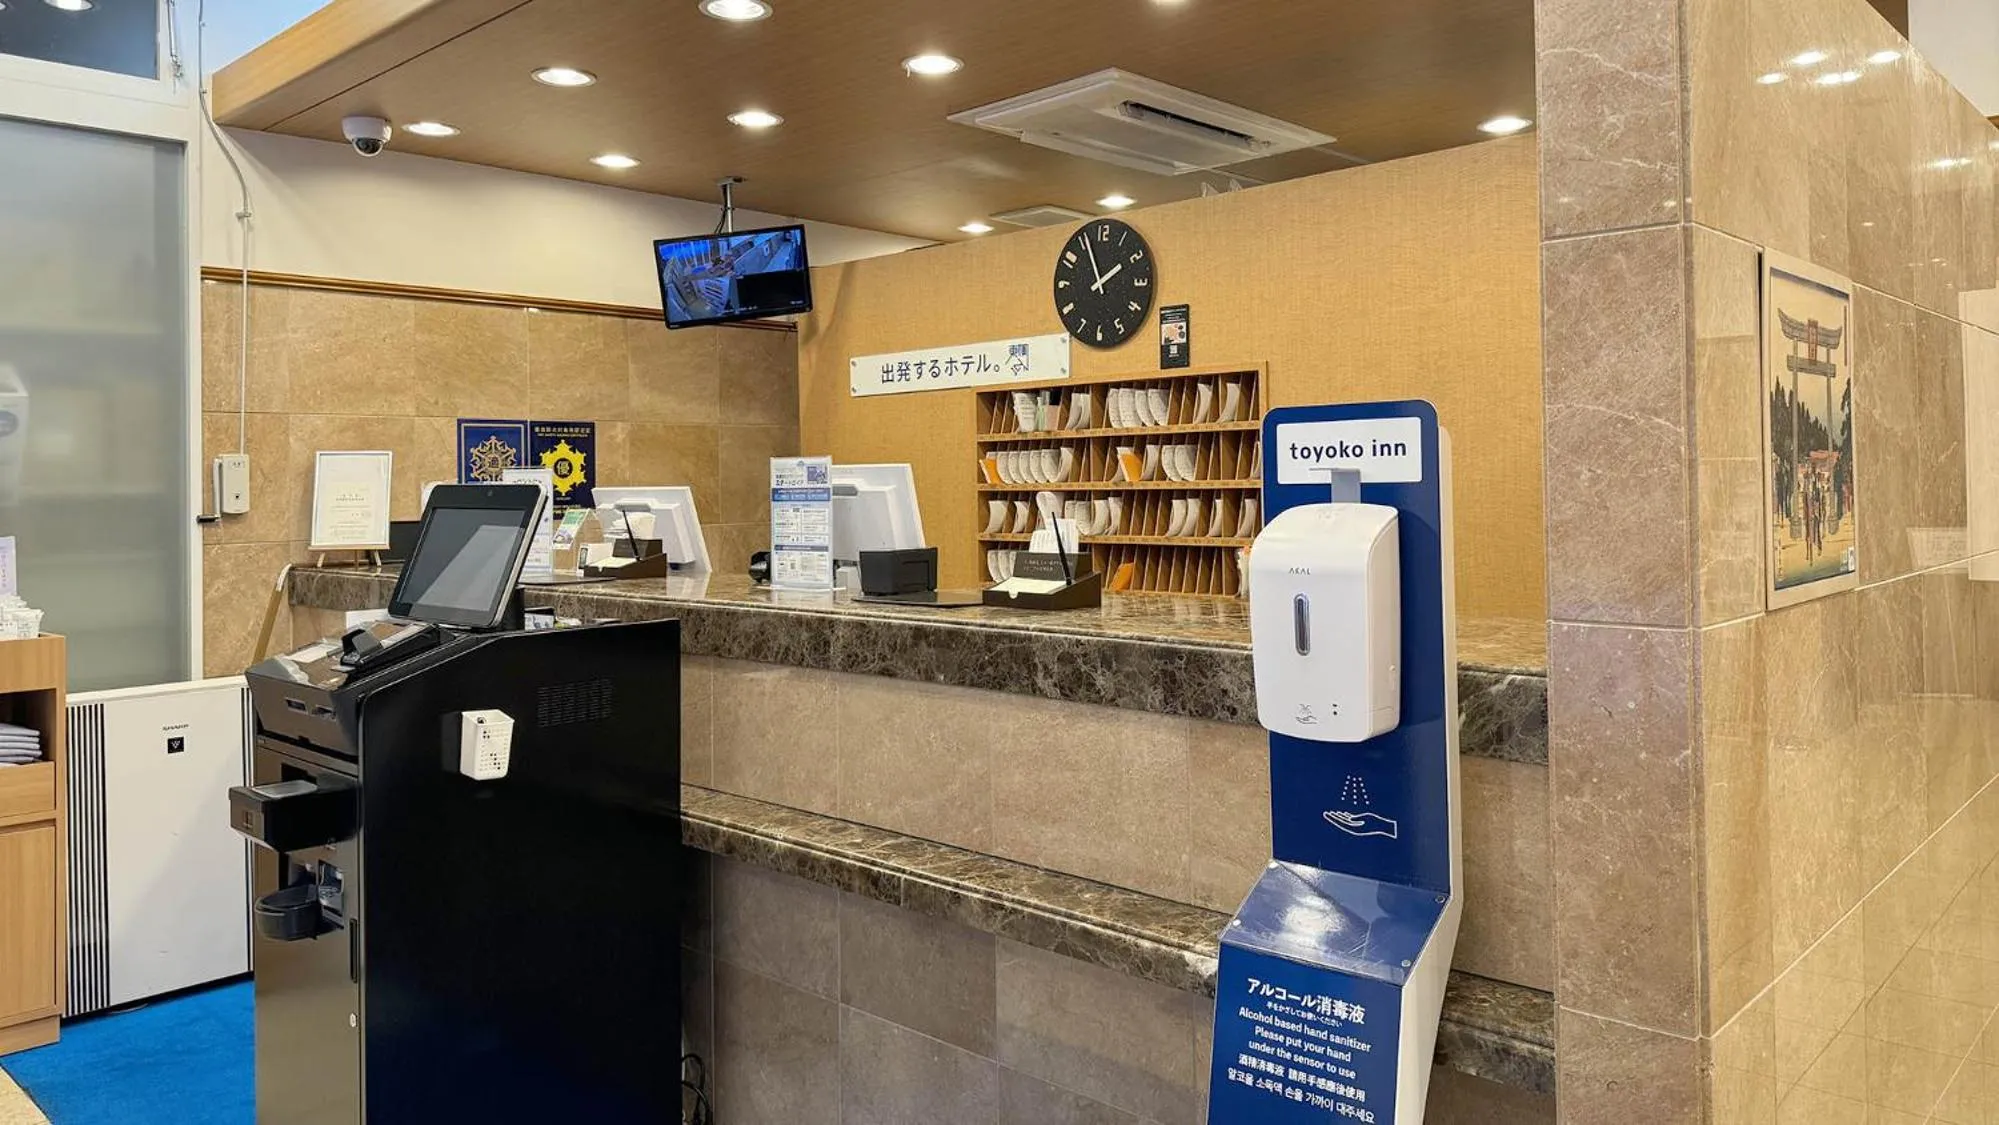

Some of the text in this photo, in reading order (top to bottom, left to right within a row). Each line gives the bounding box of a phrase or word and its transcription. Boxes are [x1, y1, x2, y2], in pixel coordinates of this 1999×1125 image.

[1097, 224, 1110, 242] 12
[1129, 249, 1144, 263] 2
[1133, 277, 1148, 287] 3
[1127, 300, 1141, 312] 4
[1077, 317, 1087, 334] 7
[1095, 324, 1103, 341] 6
[1113, 317, 1125, 335] 5
[880, 353, 1000, 384] 出発するホテル。
[1290, 439, 1407, 463] toyoko inn
[1247, 977, 1366, 1025] アルコール消毒液
[1239, 1006, 1372, 1053] Alcohol based hand sanitizer
[1255, 1025, 1351, 1062] Please put your hand
[1249, 1040, 1357, 1080] under the sensor to use
